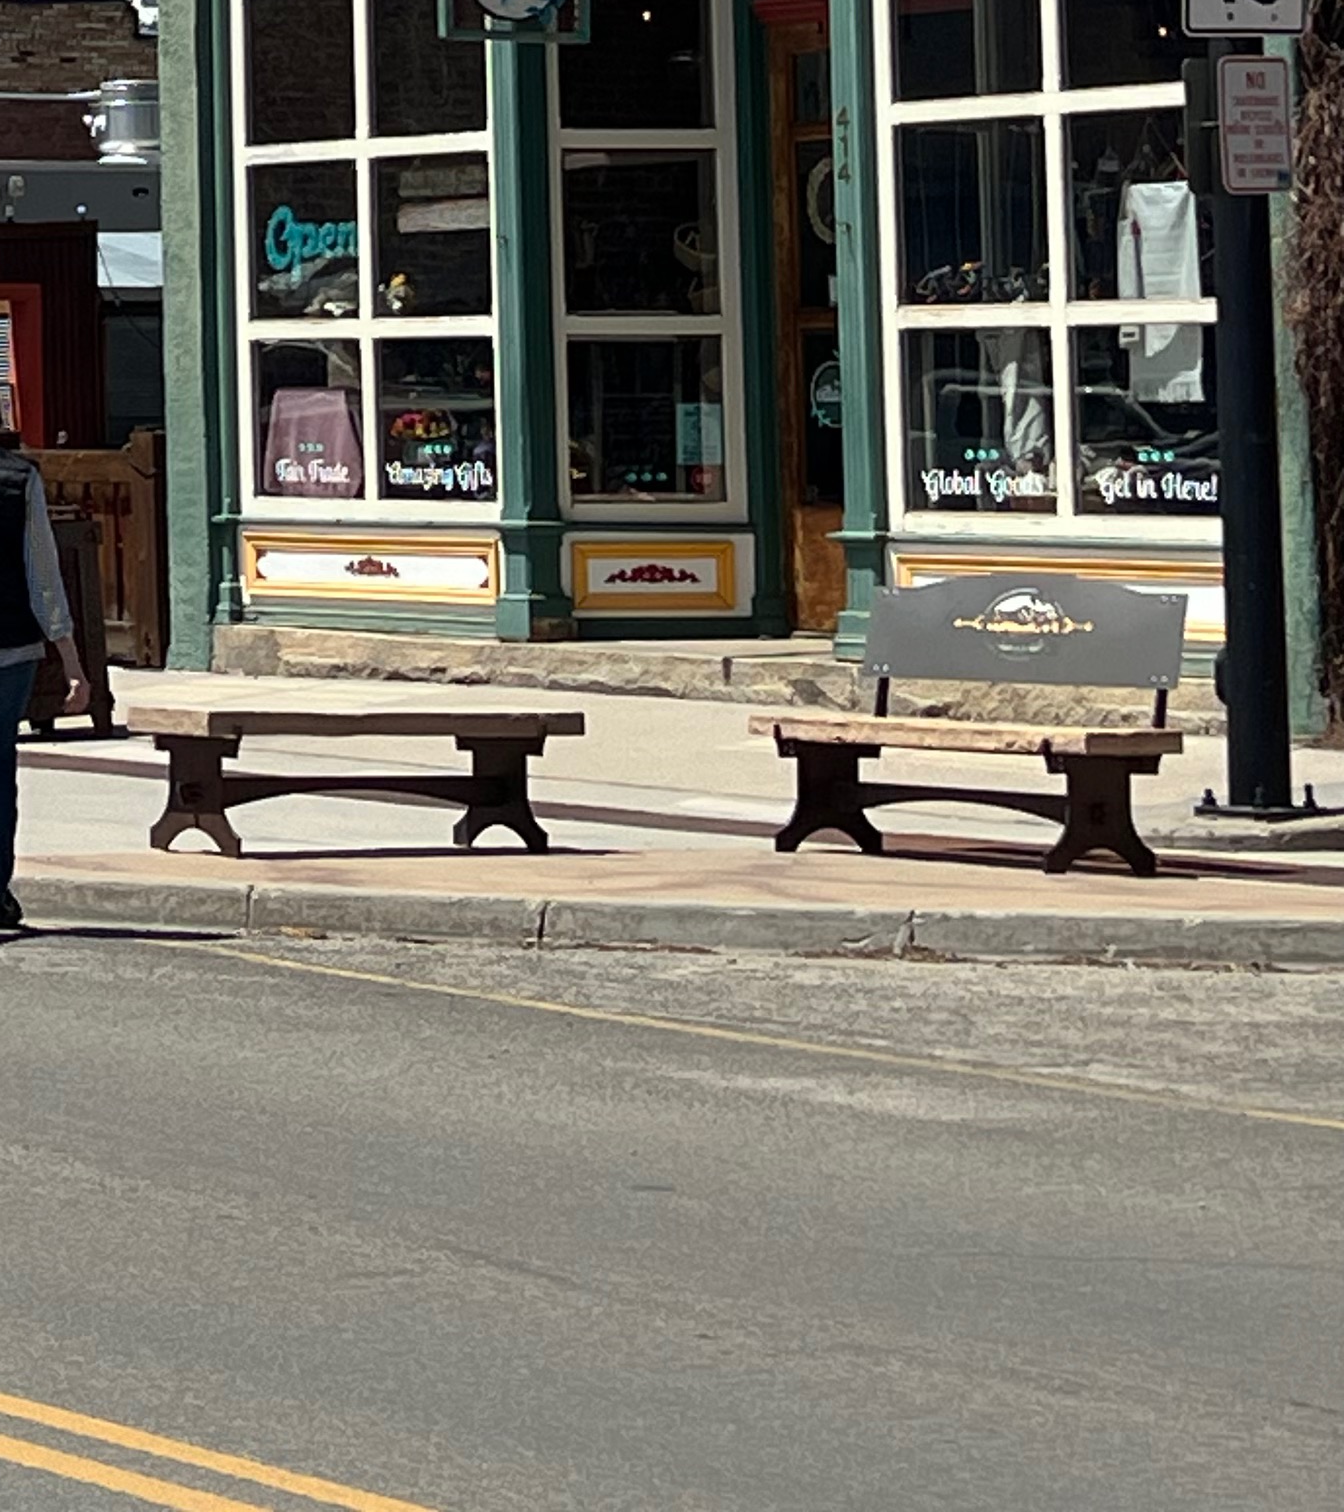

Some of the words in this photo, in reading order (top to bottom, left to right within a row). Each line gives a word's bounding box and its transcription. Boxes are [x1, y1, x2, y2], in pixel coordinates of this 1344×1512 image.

[1245, 71, 1265, 90] NO
[264, 204, 359, 286] Open
[275, 458, 304, 484] Fair
[308, 458, 350, 484] Trade
[386, 462, 454, 490] Amazing
[455, 460, 493, 490] Gifts
[921, 468, 981, 502] Global
[984, 468, 1045, 502] Goods
[1095, 466, 1131, 504] Get
[1137, 473, 1158, 499] in
[1161, 471, 1218, 502] Here!
